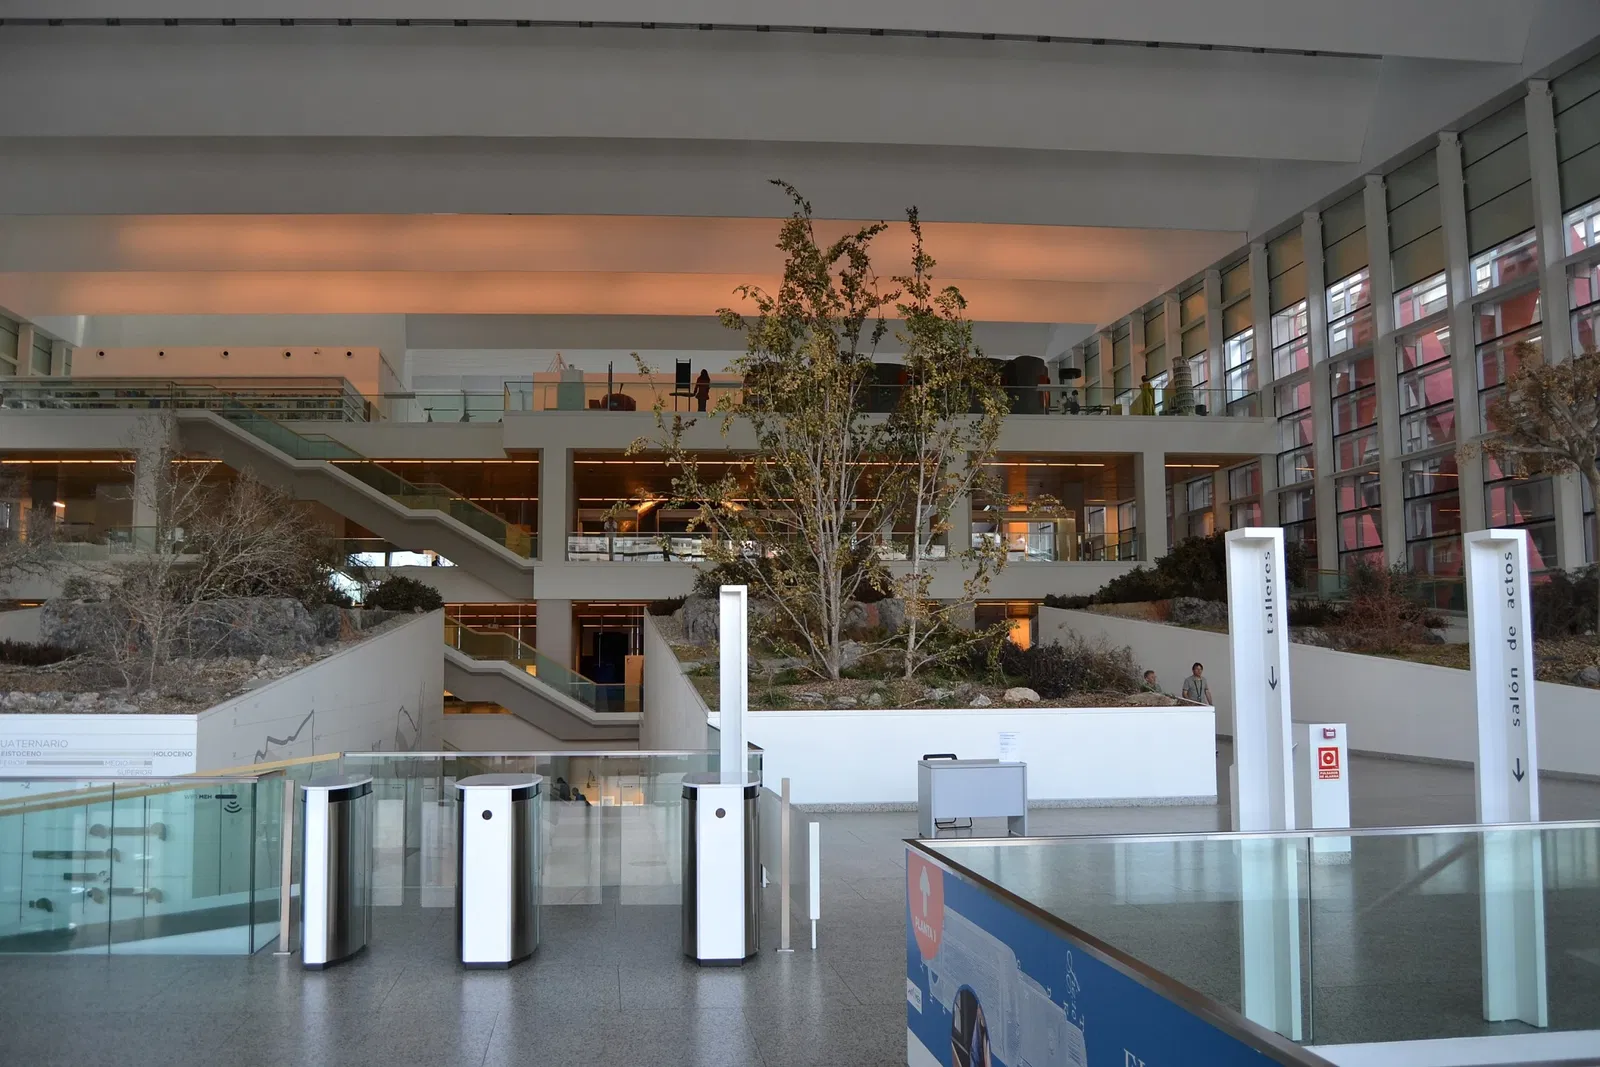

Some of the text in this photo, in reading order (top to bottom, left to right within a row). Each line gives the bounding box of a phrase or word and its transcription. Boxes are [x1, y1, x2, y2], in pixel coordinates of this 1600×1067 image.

[1264, 551, 1273, 634] talleres
[1504, 551, 1520, 727] salón de actos
[915, 916, 934, 941] PLANTA
